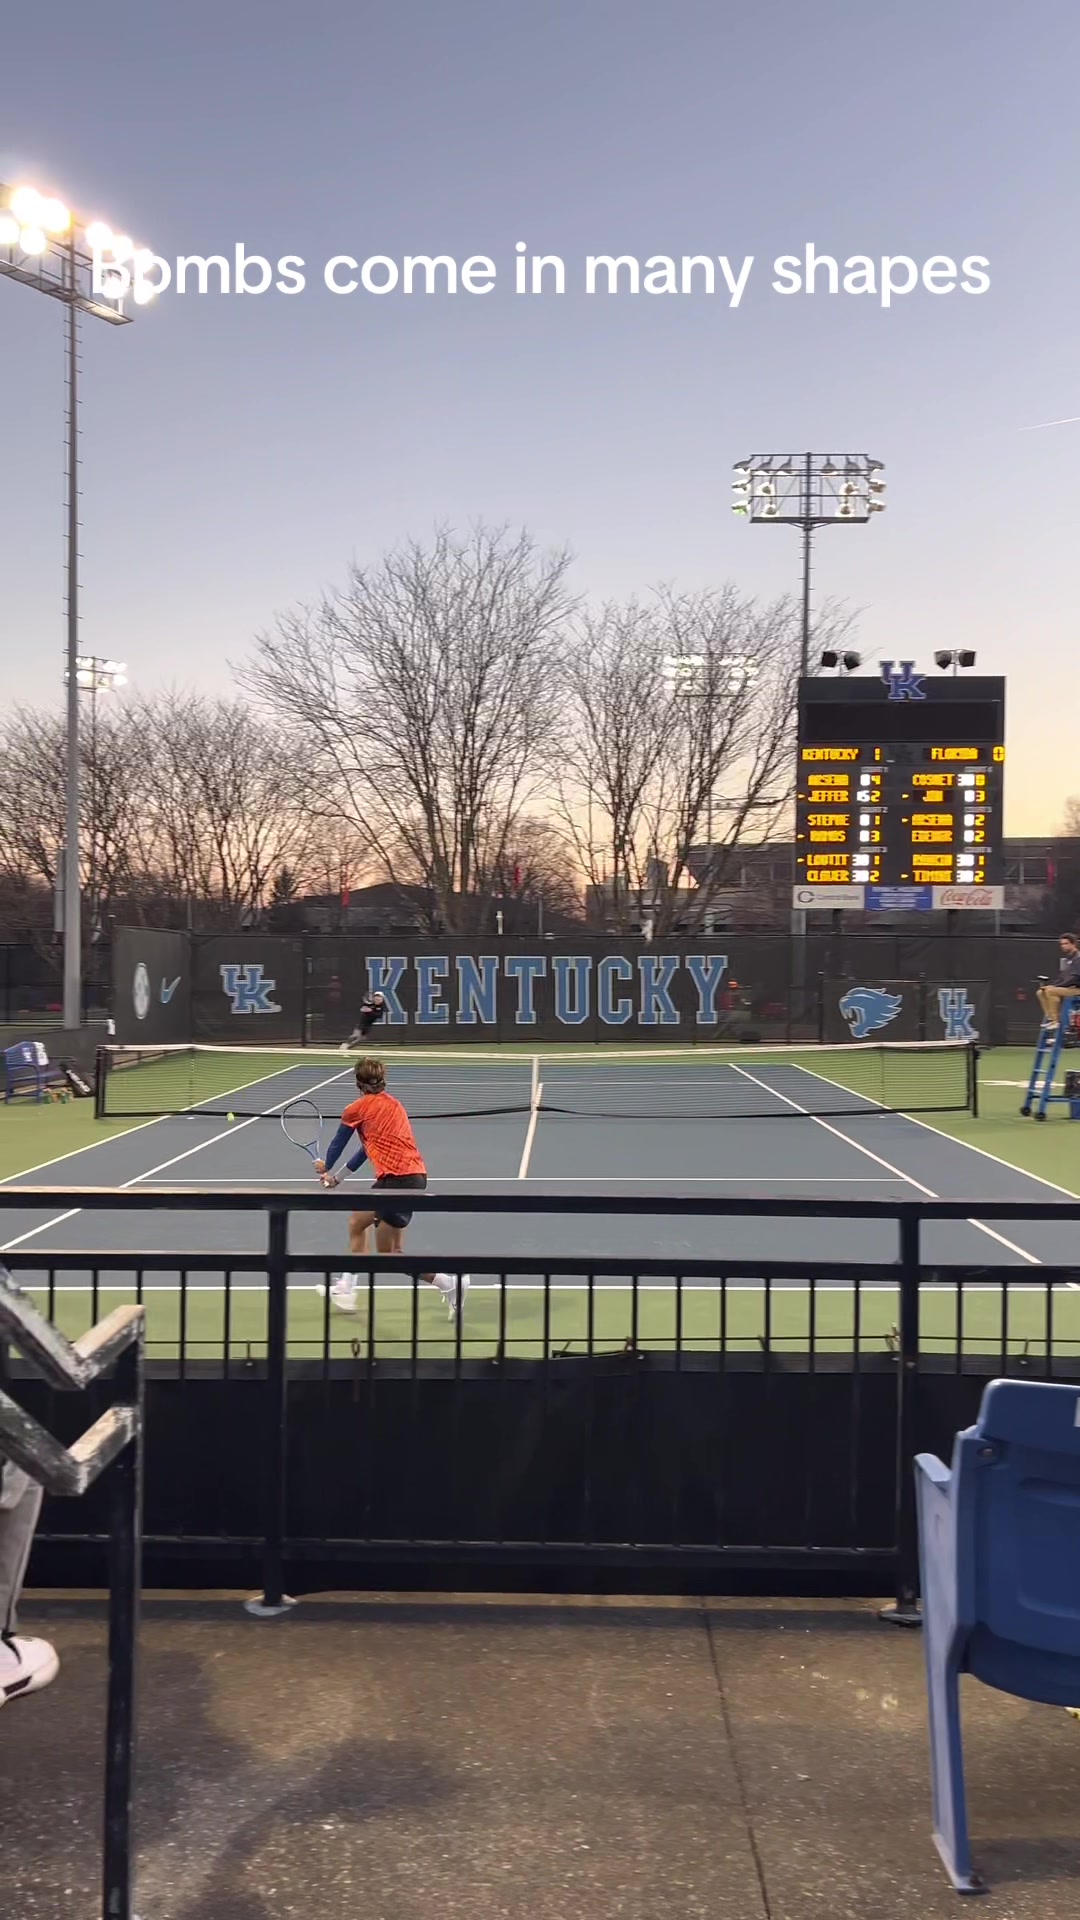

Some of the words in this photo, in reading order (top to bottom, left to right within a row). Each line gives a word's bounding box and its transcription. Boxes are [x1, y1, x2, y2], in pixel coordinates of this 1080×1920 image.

[879, 660, 926, 700] UK
[802, 748, 859, 761] KENTUCKY
[220, 964, 277, 1014] UK
[365, 955, 728, 1025] KENTUCKY
